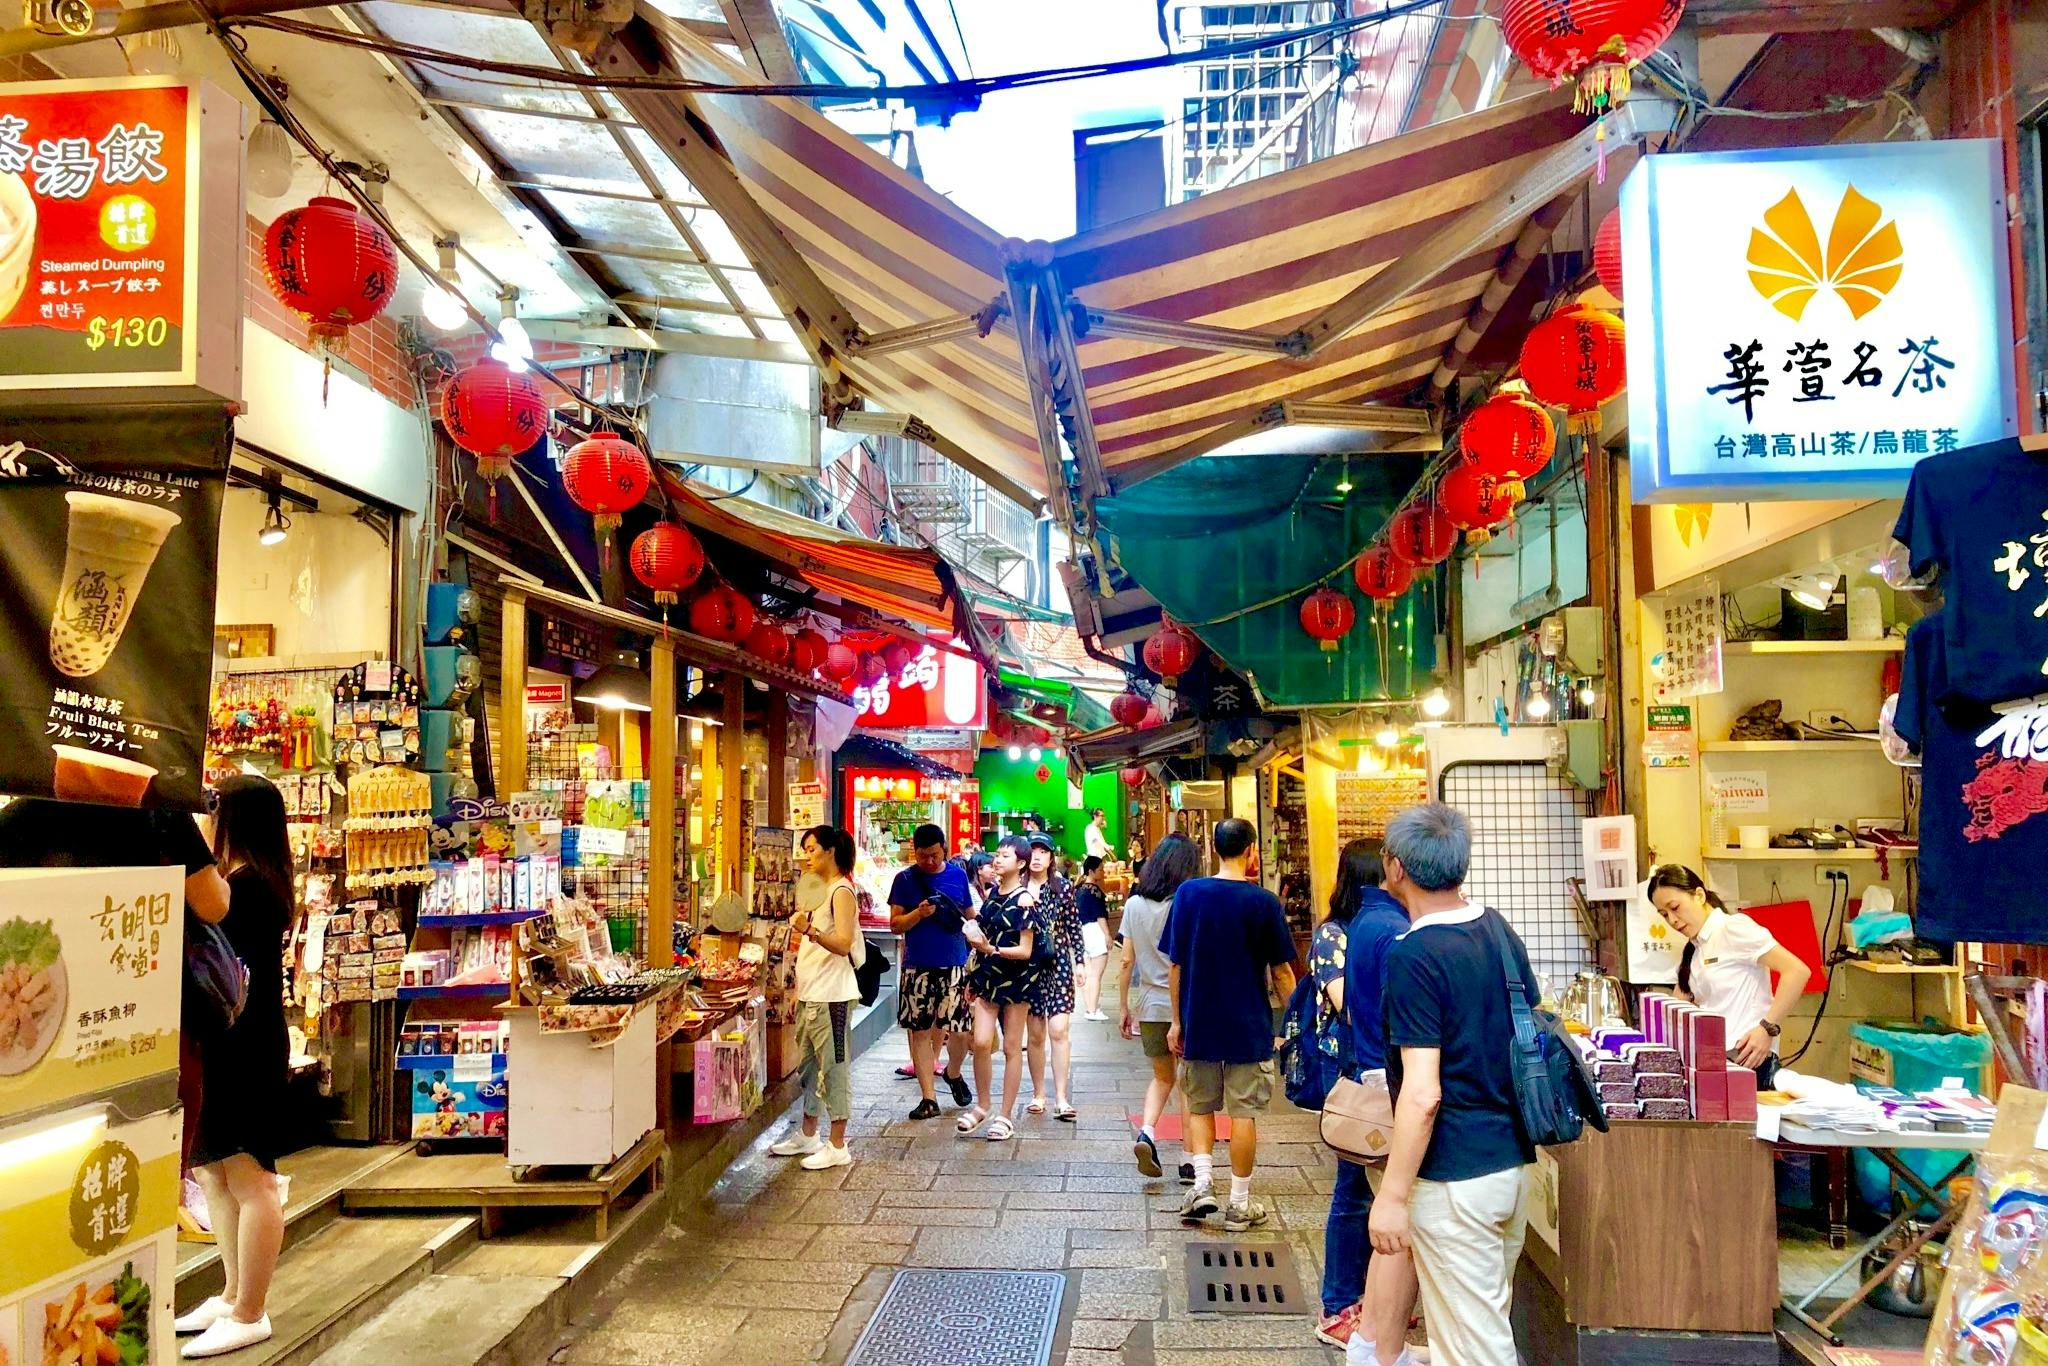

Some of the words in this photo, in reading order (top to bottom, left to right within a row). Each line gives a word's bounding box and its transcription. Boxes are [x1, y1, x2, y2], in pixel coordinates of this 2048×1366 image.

[40, 259, 99, 273] Steamed
[102, 257, 165, 273] Dumpling
[86, 316, 168, 351] $130
[1706, 336, 1956, 425] 華萱名茶
[165, 472, 200, 489] Latte
[1212, 685, 1241, 711] 茶
[44, 720, 143, 752] フルーツティー
[48, 705, 85, 724] Fruit
[87, 713, 127, 734] Black
[131, 723, 160, 740] Tea
[1710, 783, 1764, 798] aiwan
[77, 1002, 137, 1028] 香酥魚柳
[88, 1193, 131, 1243] 首選
